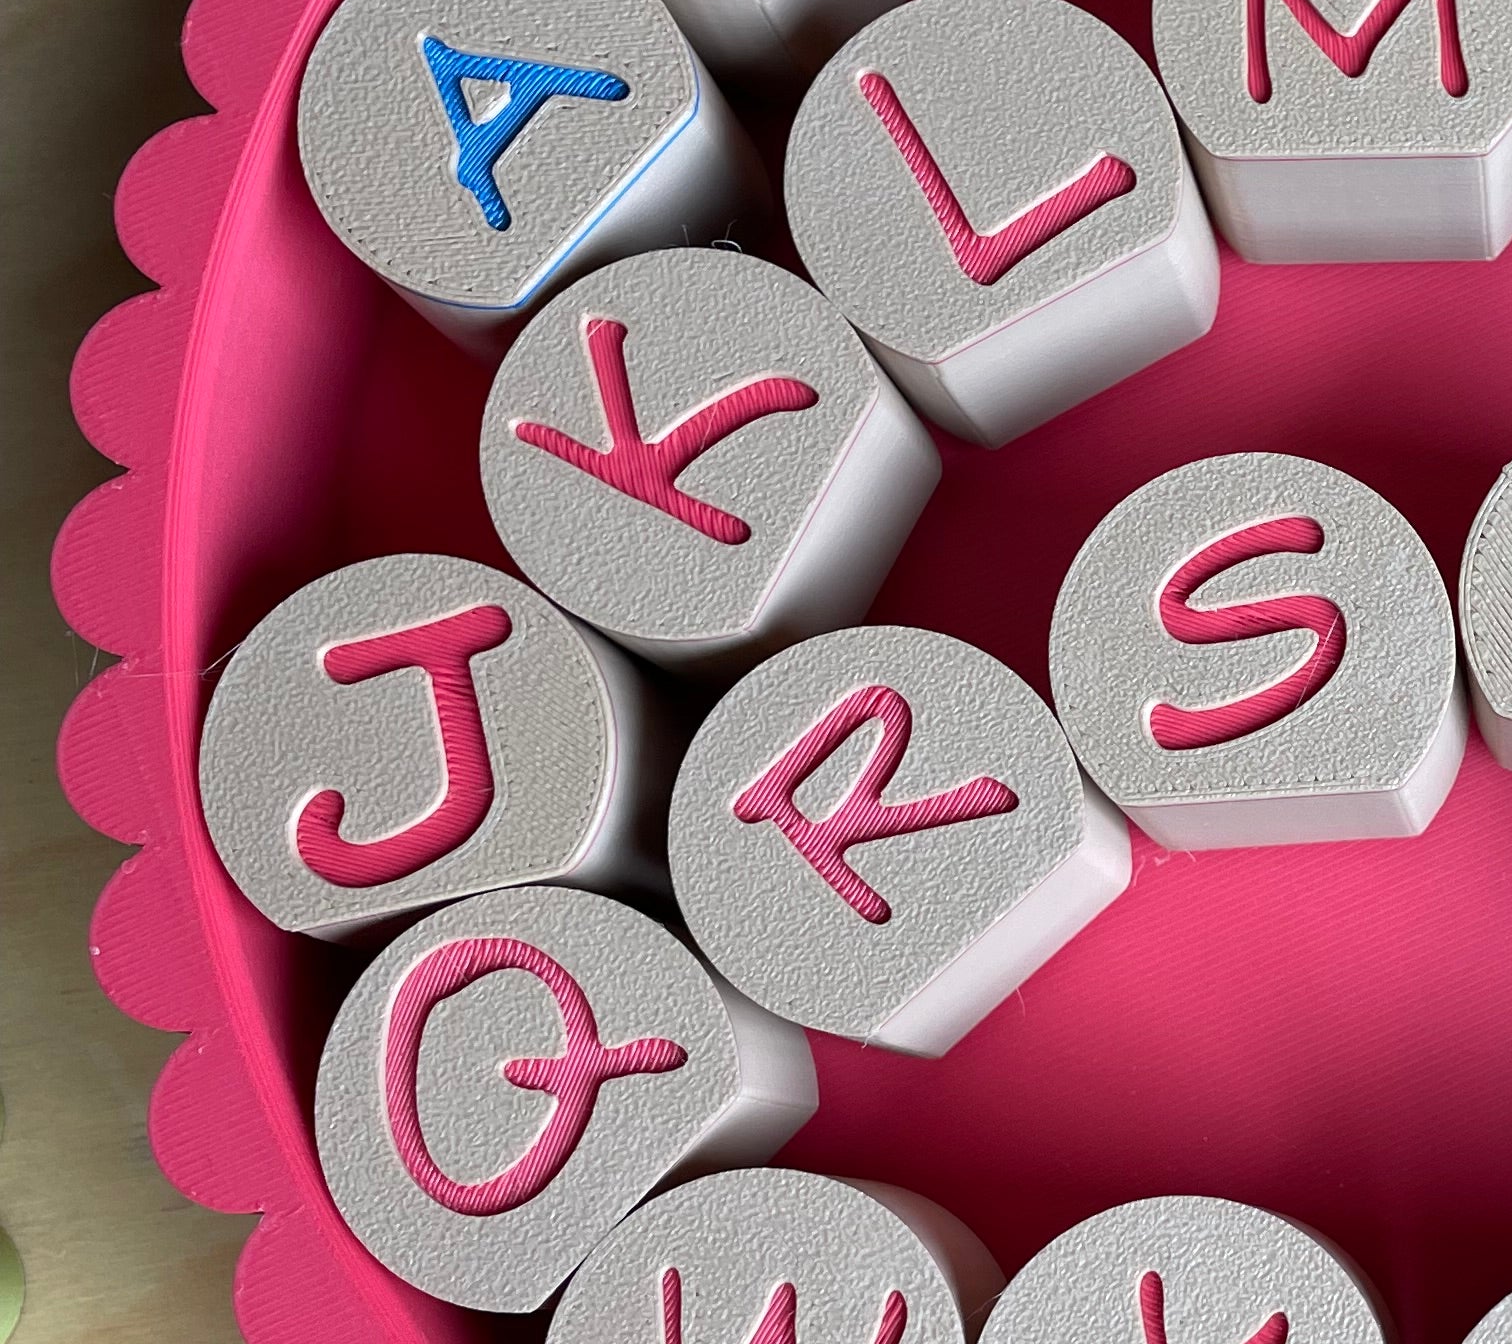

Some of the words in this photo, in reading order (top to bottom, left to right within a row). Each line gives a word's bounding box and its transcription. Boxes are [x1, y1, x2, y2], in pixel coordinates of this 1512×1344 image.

[423, 37, 626, 230] A
[861, 73, 1134, 284] L
[516, 320, 819, 545] K
[297, 605, 512, 888] J
[1150, 517, 1346, 750] S
[734, 686, 1018, 922] R
[386, 938, 686, 1216] Q
